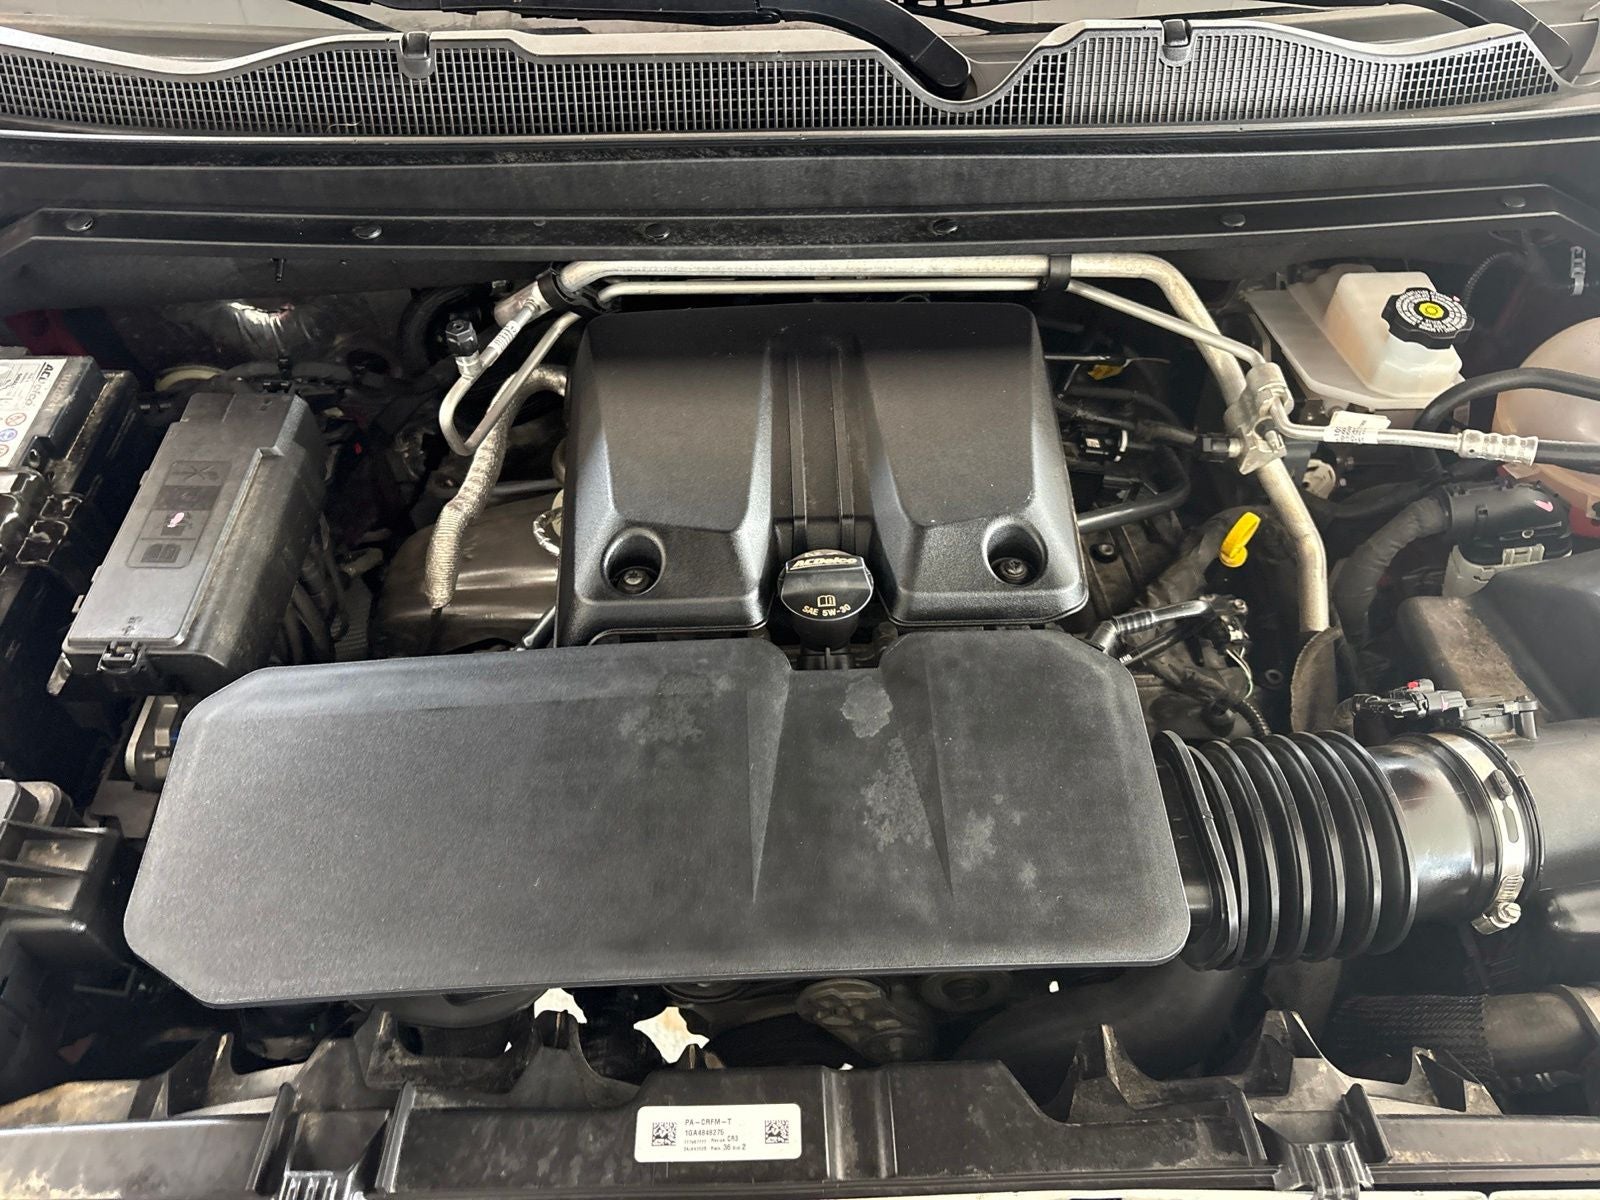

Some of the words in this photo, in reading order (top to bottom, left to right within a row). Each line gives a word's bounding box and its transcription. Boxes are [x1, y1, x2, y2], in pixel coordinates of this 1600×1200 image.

[789, 556, 858, 571] ACDelco
[802, 605, 819, 616] SAE
[822, 603, 852, 617] 5W-30
